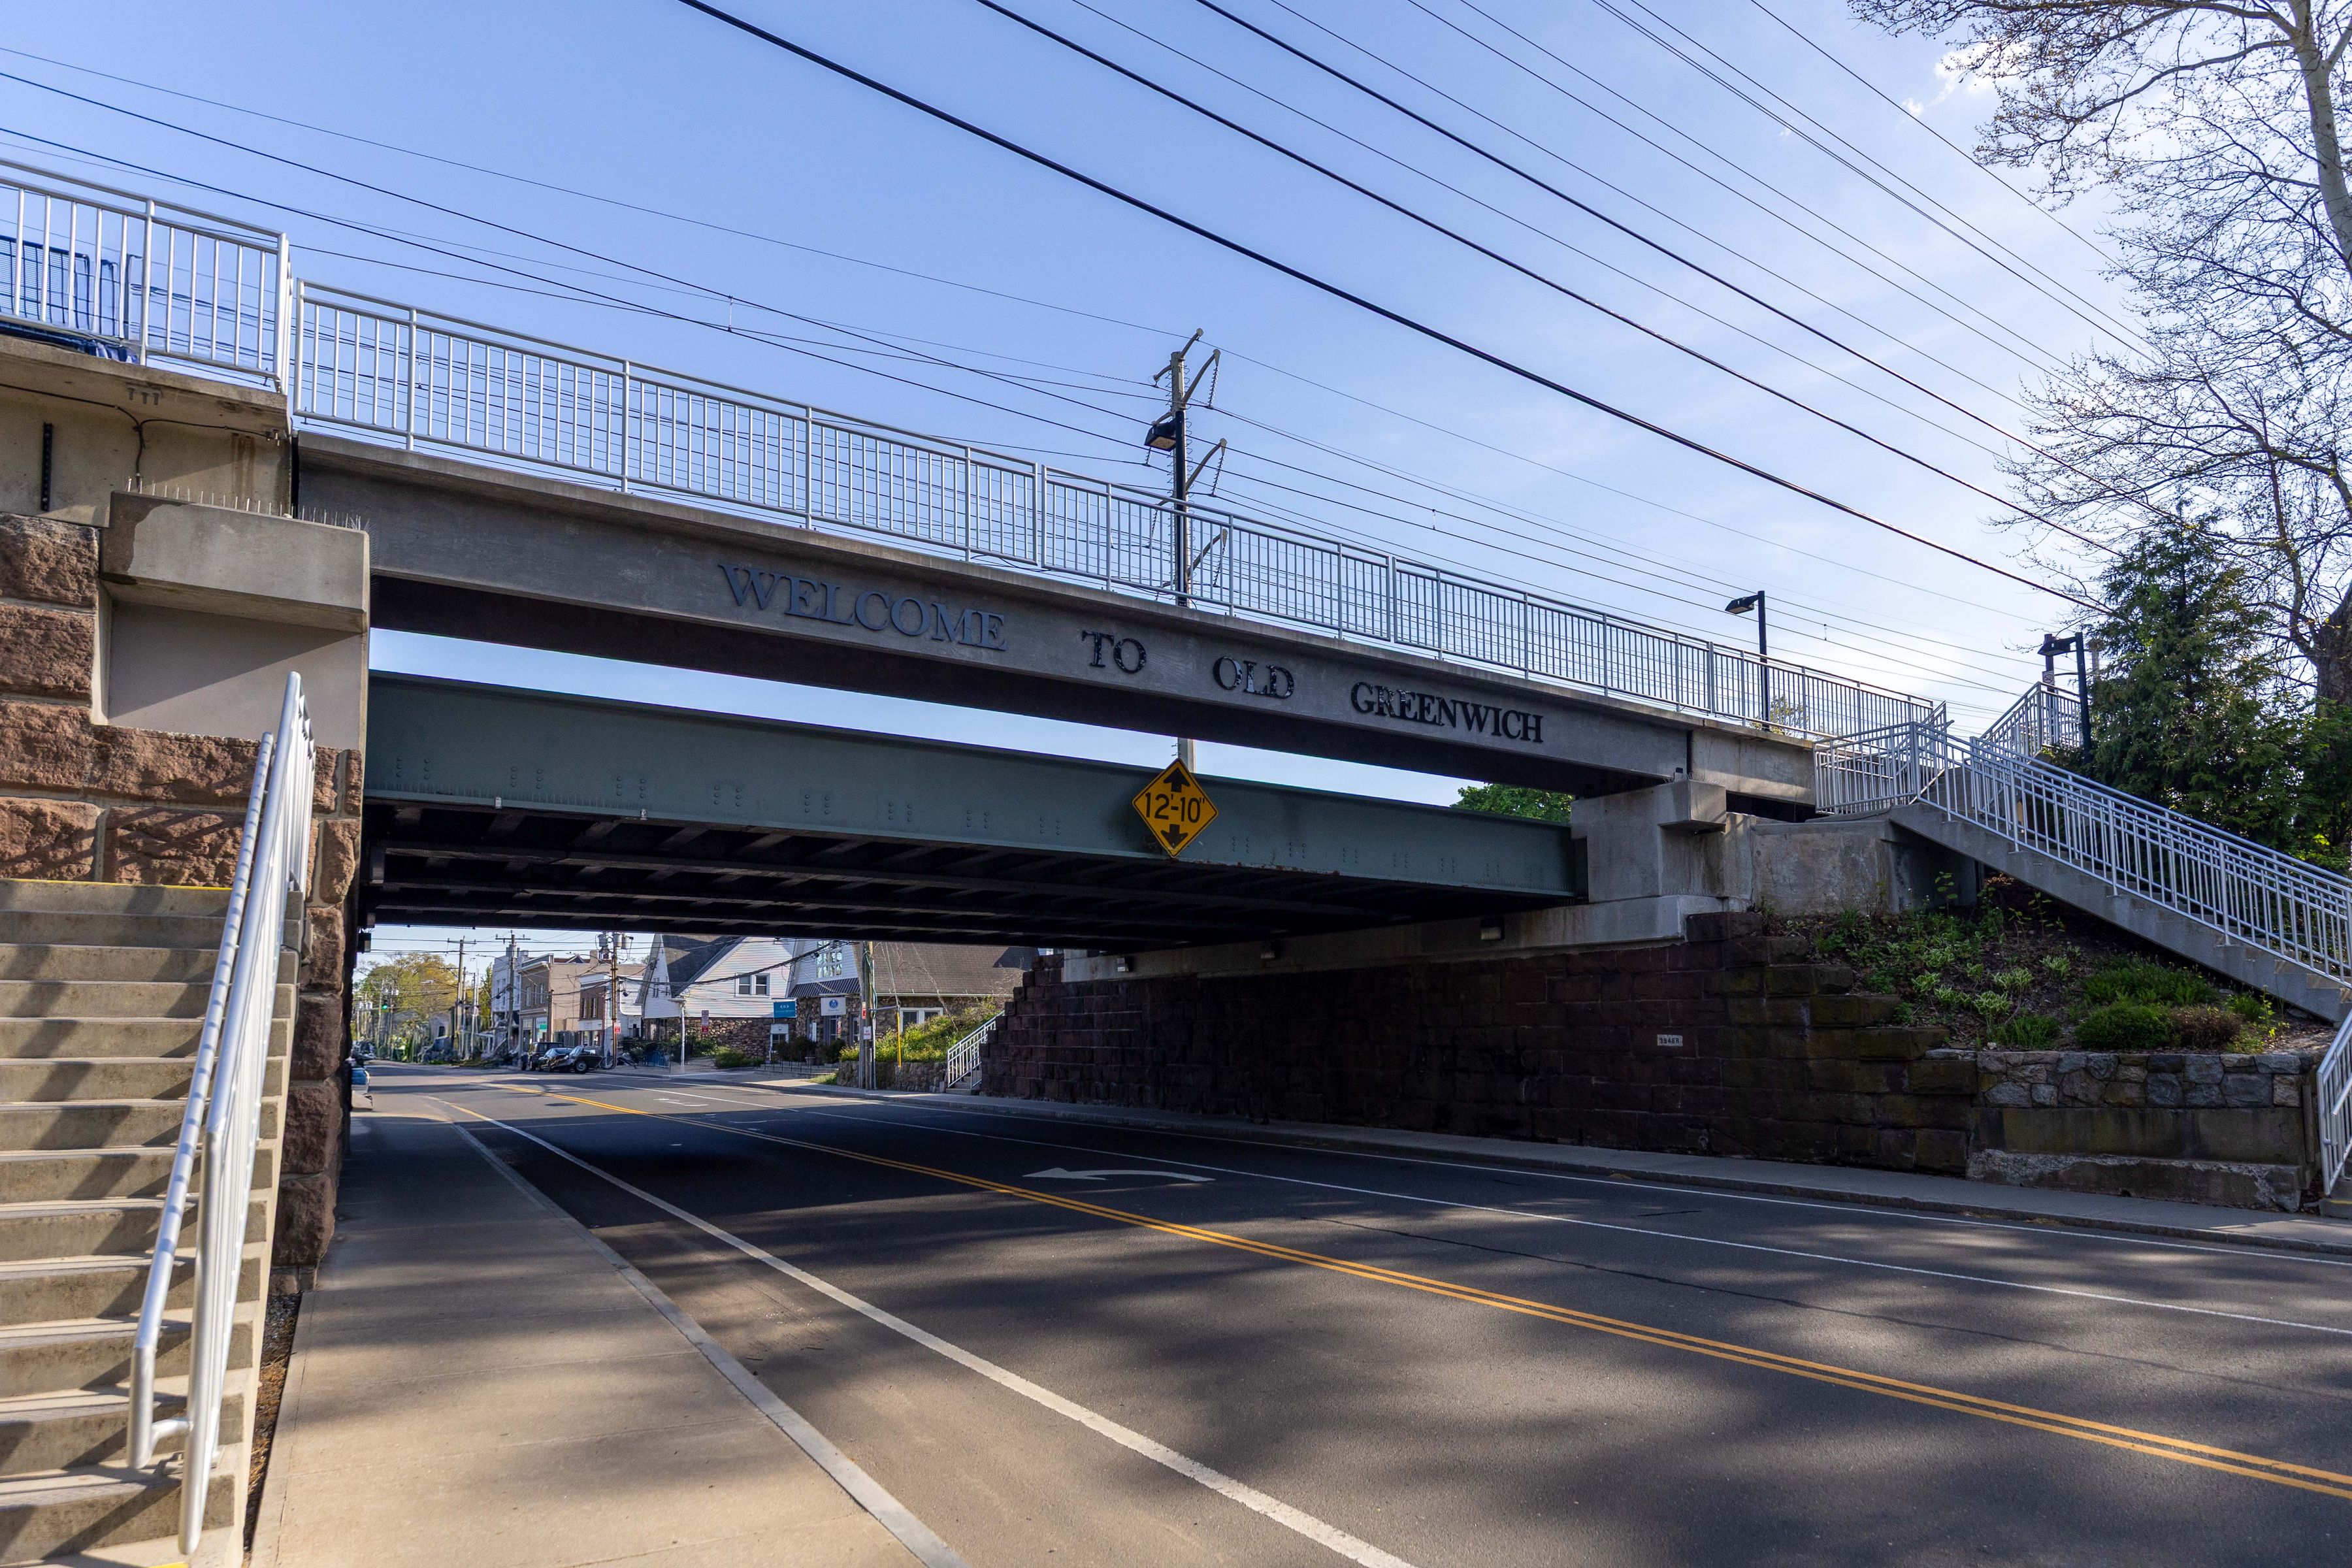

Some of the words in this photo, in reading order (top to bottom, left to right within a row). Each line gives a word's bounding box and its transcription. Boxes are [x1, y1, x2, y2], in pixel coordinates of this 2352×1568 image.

[719, 563, 1007, 651] WELCOME
[1082, 629, 1147, 674] TO
[1213, 655, 1295, 699] OLD
[1351, 681, 1543, 743] GREENWICH
[1145, 792, 1205, 823] 12'-10"
